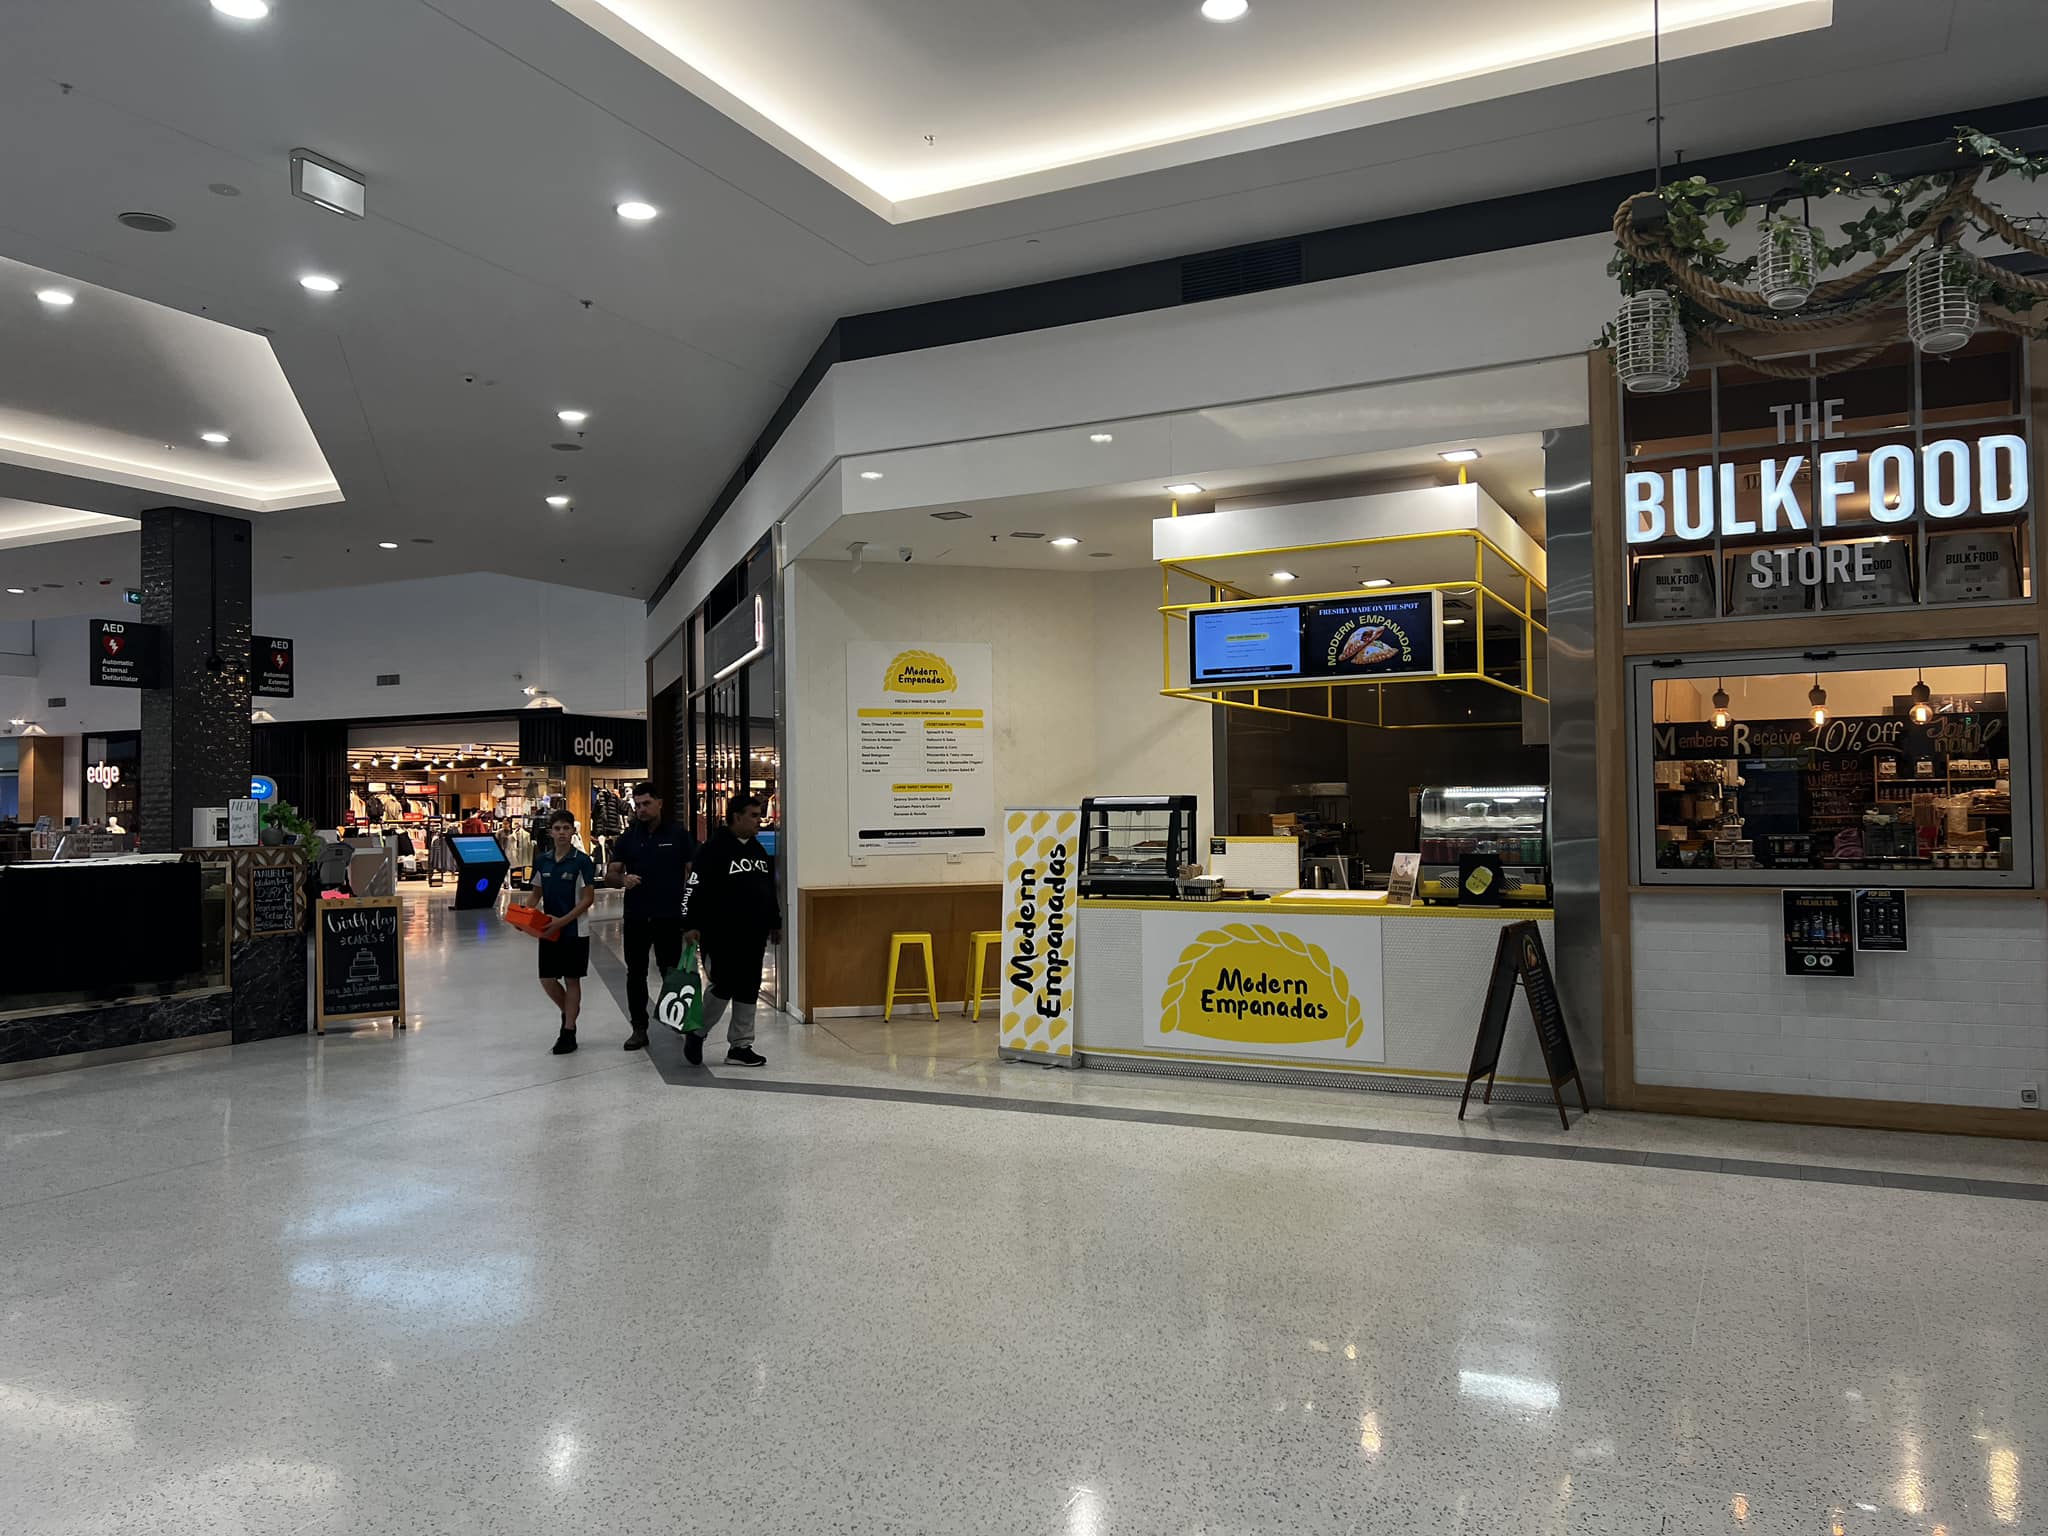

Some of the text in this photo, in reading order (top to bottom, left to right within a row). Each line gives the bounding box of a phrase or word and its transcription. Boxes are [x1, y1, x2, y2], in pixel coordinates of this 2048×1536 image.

[1769, 398, 1845, 444] THE
[1625, 434, 2029, 543] BULK FOOD
[1946, 551, 1999, 564] BULK FOOD
[1751, 544, 1877, 589] STORE
[1656, 574, 1699, 586] BULK FOOD
[1319, 607, 1349, 616] FRESHLY
[1351, 606, 1372, 614] MADE
[1399, 602, 1420, 610] SPOT
[102, 623, 125, 633] AED
[270, 640, 289, 650] AED
[1327, 614, 1412, 667] MODERN EMPANADAS
[102, 658, 134, 666] Automatic
[102, 666, 128, 674] External
[904, 666, 938, 677] Modern
[101, 674, 139, 683] Defibrillator
[898, 674, 945, 686] Empanadas
[1653, 726, 1729, 756] Members
[1733, 723, 1802, 755] Receive
[1804, 720, 1863, 753] 10%
[574, 731, 614, 763] edge
[1841, 759, 1858, 771] DO
[87, 760, 120, 790] edge
[1010, 867, 1039, 994] Modern
[1037, 843, 1069, 1018] Empanadas
[347, 934, 378, 945] CAKES
[1216, 967, 1308, 996] Modern
[1200, 989, 1329, 1020] Empanadas
